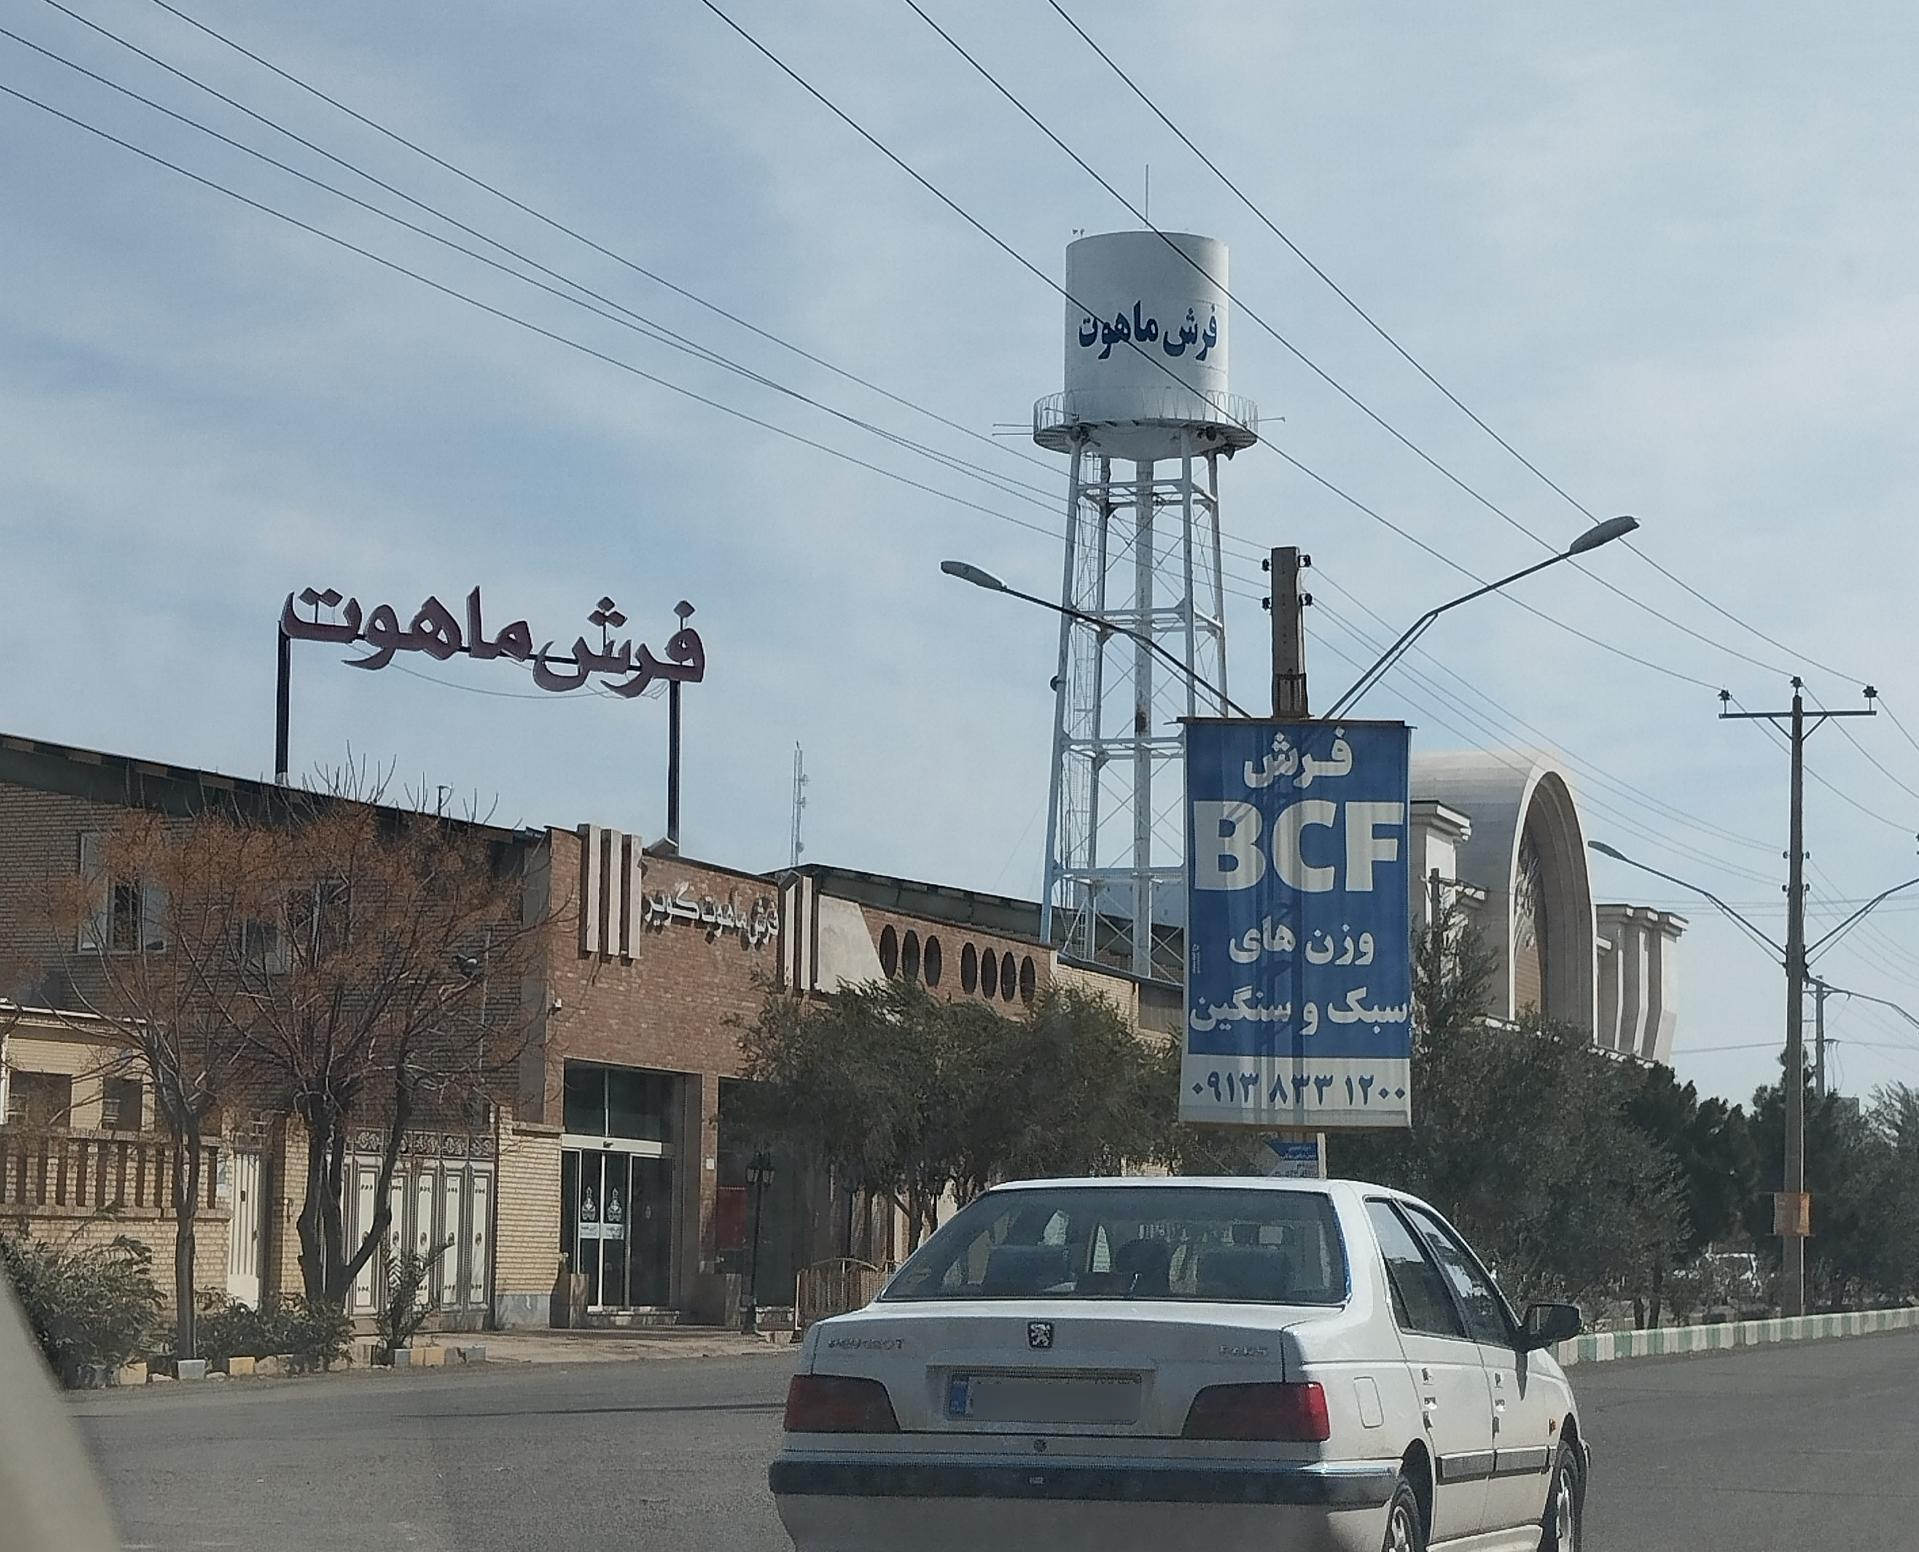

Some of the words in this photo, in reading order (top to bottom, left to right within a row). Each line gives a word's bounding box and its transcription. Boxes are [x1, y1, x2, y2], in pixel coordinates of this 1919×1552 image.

[1079, 300, 1158, 360] ماهوت
[1163, 304, 1217, 361] فرش
[280, 586, 532, 670] ماهوت
[533, 597, 705, 699] فرش
[1244, 726, 1352, 788] فرش
[1194, 800, 1404, 892] BCF
[1229, 915, 1296, 964] های
[1305, 923, 1374, 965] وزن
[1190, 986, 1291, 1031] سنگین
[1299, 1002, 1318, 1035] و
[1328, 987, 1408, 1034] سبک
[1192, 1071, 1259, 1103] ۰۹۱۳
[1269, 1073, 1334, 1105] ۸۳۳
[1345, 1074, 1405, 1106] ۱۲۰۰
